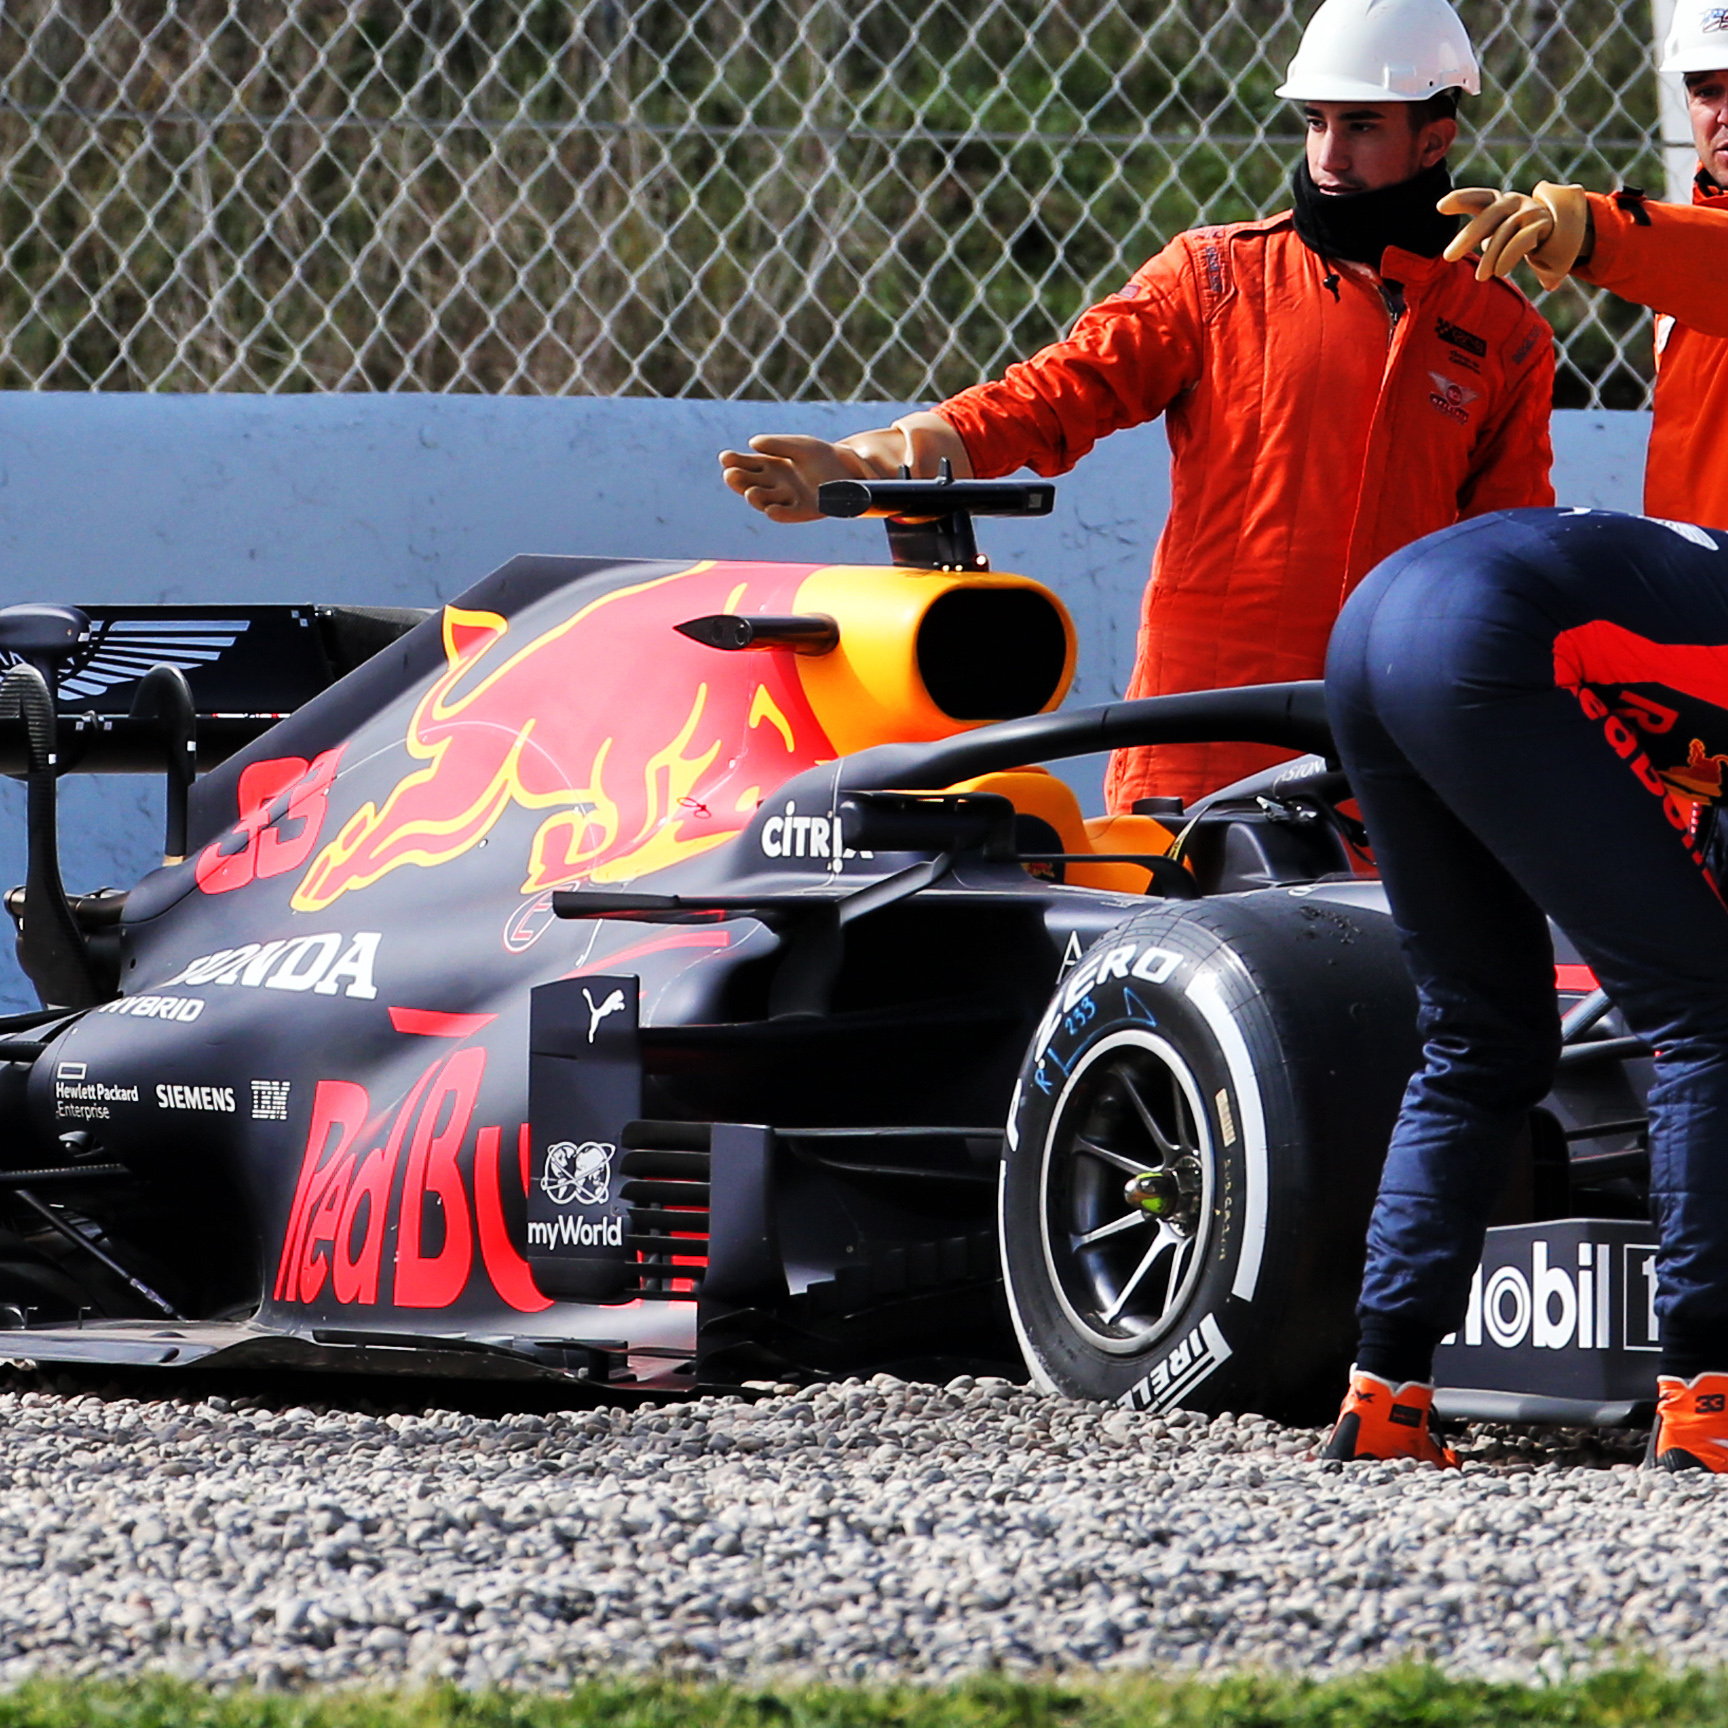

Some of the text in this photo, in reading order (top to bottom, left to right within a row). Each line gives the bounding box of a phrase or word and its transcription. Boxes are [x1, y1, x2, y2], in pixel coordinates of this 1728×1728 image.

[195, 742, 351, 894] 33
[157, 932, 383, 1000] HONDA
[98, 994, 206, 1023] HYBRID
[1034, 943, 1184, 1063] ZERO
[55, 1081, 140, 1103] Hewlett Packard
[155, 1084, 236, 1113] SIEMENS
[250, 1080, 291, 1120] IBM
[57, 1101, 111, 1122] Enterprise
[273, 1059, 443, 1305] Red
[526, 1214, 623, 1250] myWorld
[1695, 1393, 1726, 1414] 33
